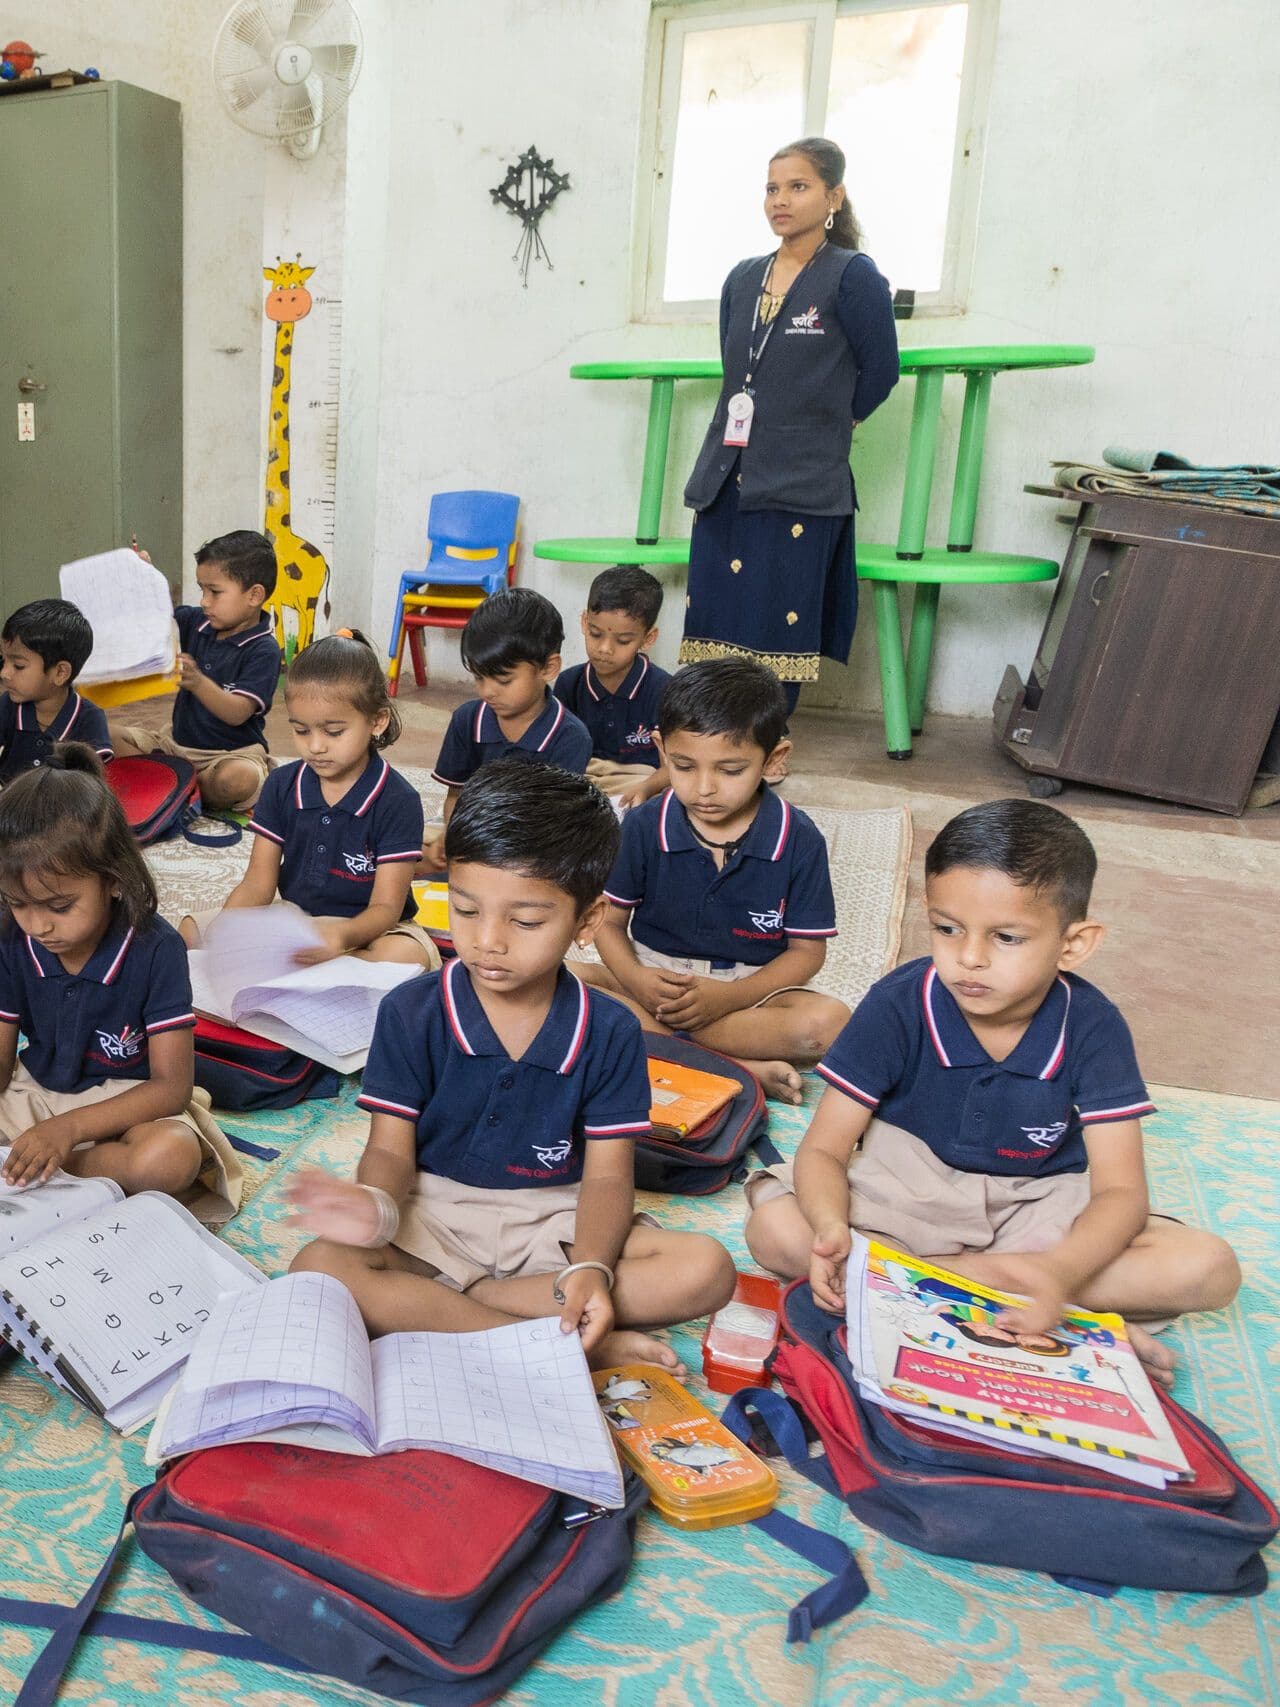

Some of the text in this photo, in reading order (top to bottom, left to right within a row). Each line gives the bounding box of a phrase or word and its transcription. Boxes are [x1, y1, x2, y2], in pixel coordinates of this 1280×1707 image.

[531, 1139, 572, 1170] स्ने
[88, 1233, 193, 1334] P Q S
[108, 1222, 210, 1322] U V X
[20, 1266, 128, 1375] A C D
[45, 1256, 151, 1361] F G I
[92, 1268, 173, 1346] K M
[906, 1361, 1130, 1417] Assessment Book
[932, 1358, 980, 1374] Series
[974, 1352, 1040, 1372] Nursery
[975, 1387, 1067, 1414] Firefly
